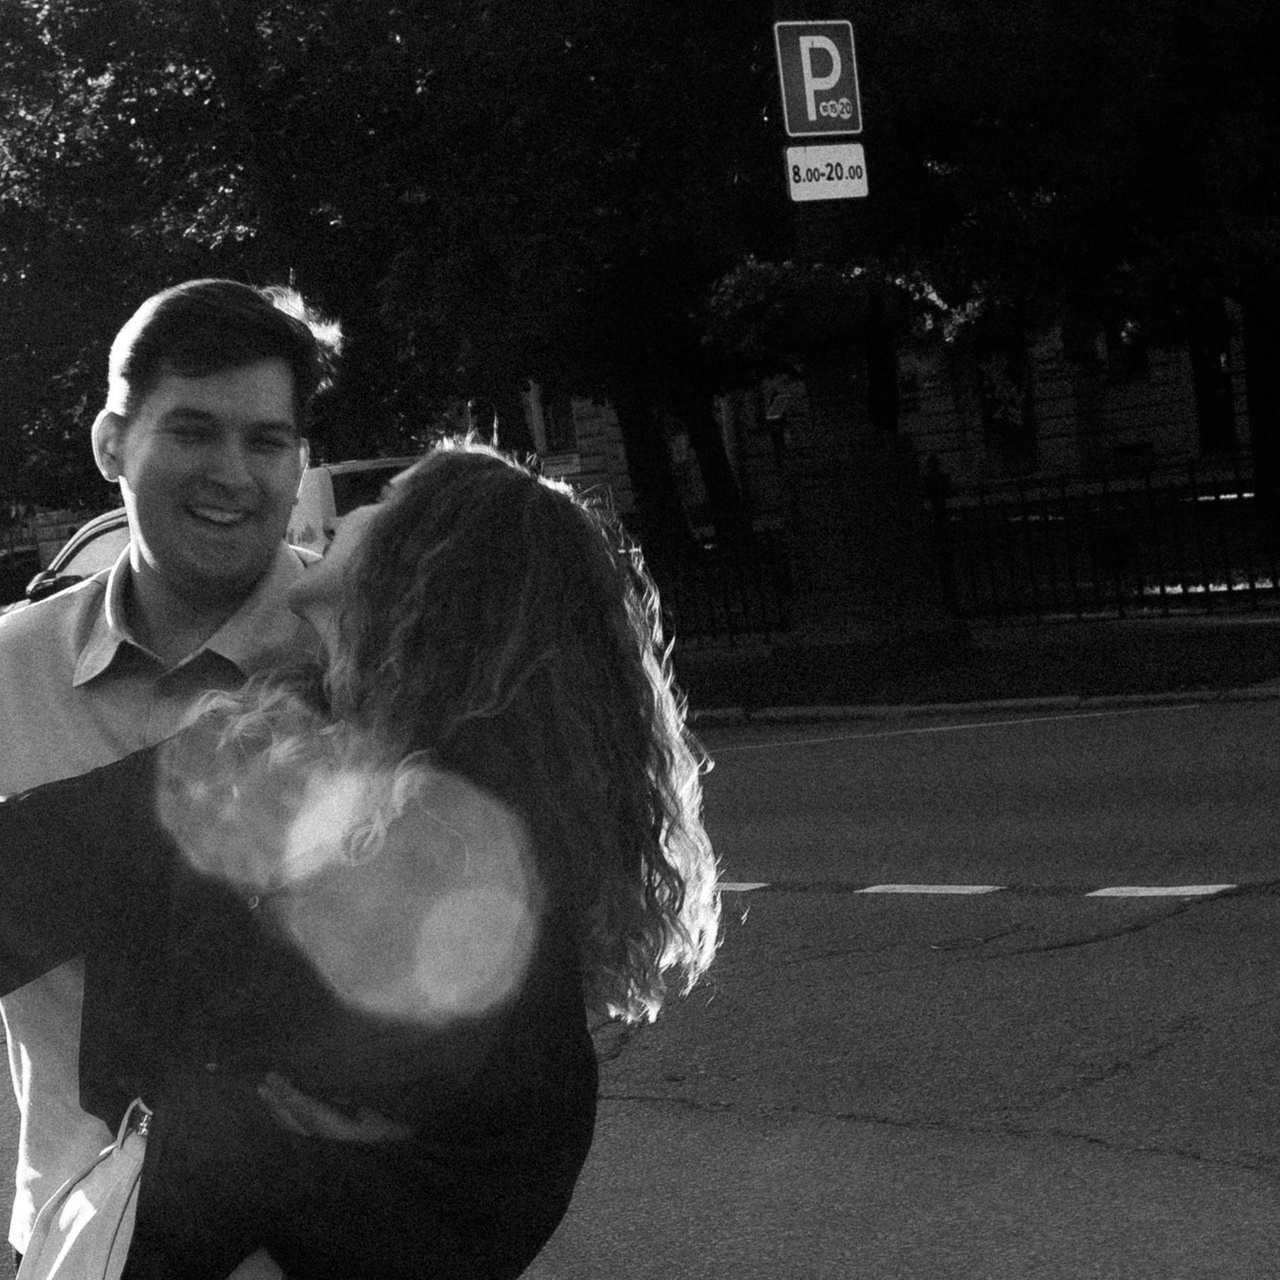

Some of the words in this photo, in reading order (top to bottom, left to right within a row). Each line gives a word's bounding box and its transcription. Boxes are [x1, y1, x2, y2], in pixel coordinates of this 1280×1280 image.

[799, 35, 842, 121] P
[839, 101, 851, 115] 20
[792, 162, 863, 184] 8.00-20.00
